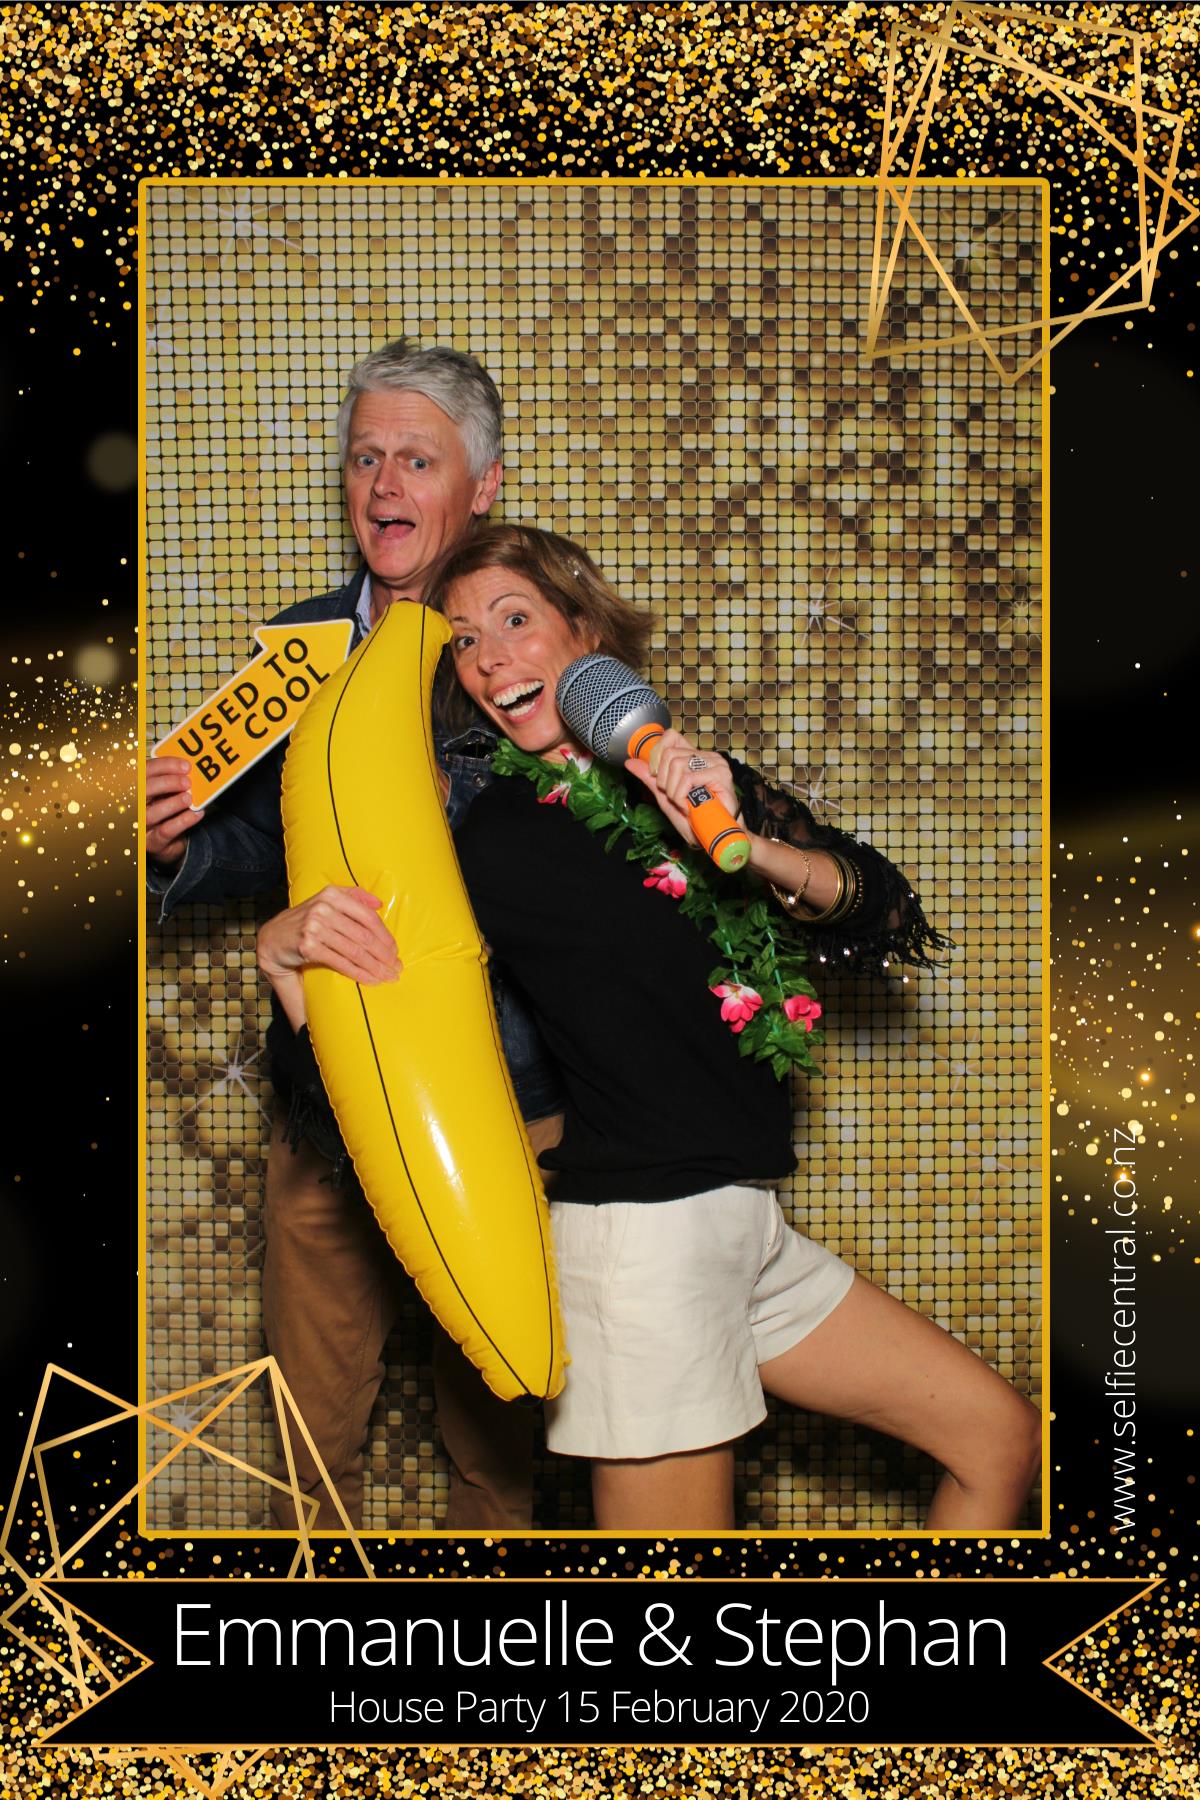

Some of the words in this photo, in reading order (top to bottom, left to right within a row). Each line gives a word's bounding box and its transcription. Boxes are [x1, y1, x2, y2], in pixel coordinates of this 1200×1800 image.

[178, 682, 259, 756] USED
[263, 638, 308, 679] TO
[195, 738, 240, 782] BE
[245, 664, 330, 739] COOL
